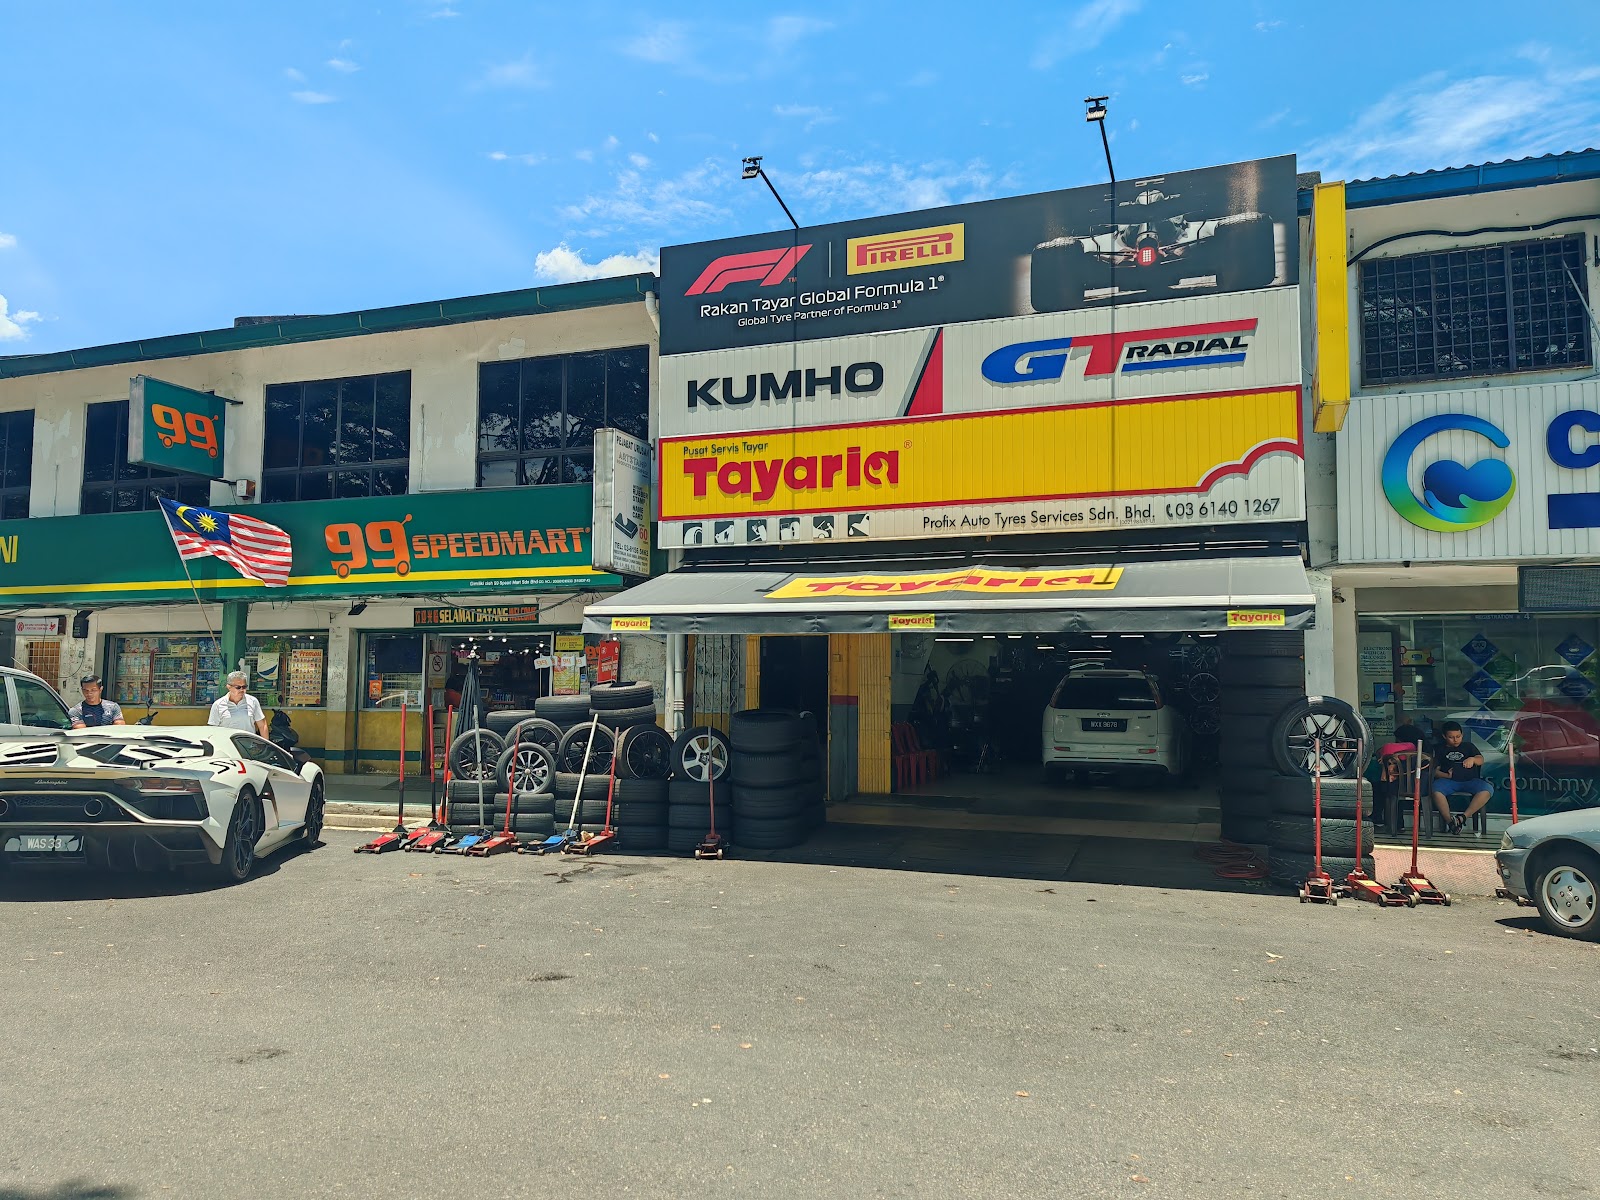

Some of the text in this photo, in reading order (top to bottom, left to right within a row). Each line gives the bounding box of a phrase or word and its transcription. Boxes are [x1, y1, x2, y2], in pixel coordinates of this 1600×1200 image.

[856, 232, 954, 267] PIRELLI
[701, 303, 748, 318] Rakan
[752, 296, 795, 316] Tayar
[800, 288, 850, 307] Global
[855, 281, 924, 299] Formula
[738, 314, 768, 327] Global
[770, 312, 792, 325] Tyre
[794, 308, 831, 321] Partner
[834, 306, 845, 316] of
[847, 301, 889, 314] Formula
[1126, 335, 1248, 360] RADIAL
[688, 361, 884, 408] KUMHO
[151, 403, 219, 458] 99
[683, 441, 769, 456] Pusat Servis Tayar
[683, 446, 899, 502] Tayaria
[923, 503, 1156, 530] Profix Auto Tyres Services Sdn. Bhd.
[1175, 497, 1281, 518] 03 6140 1267
[639, 528, 648, 541] 60
[324, 513, 413, 580] 99
[807, 573, 1096, 592] Tayaria
[439, 609, 475, 623] SELAMAT
[476, 608, 508, 622] DATANG
[615, 619, 648, 629] Tayaria
[892, 616, 932, 625] Tayaria
[1231, 613, 1281, 622] Tayaria
[27, 838, 62, 849] WAS 33
